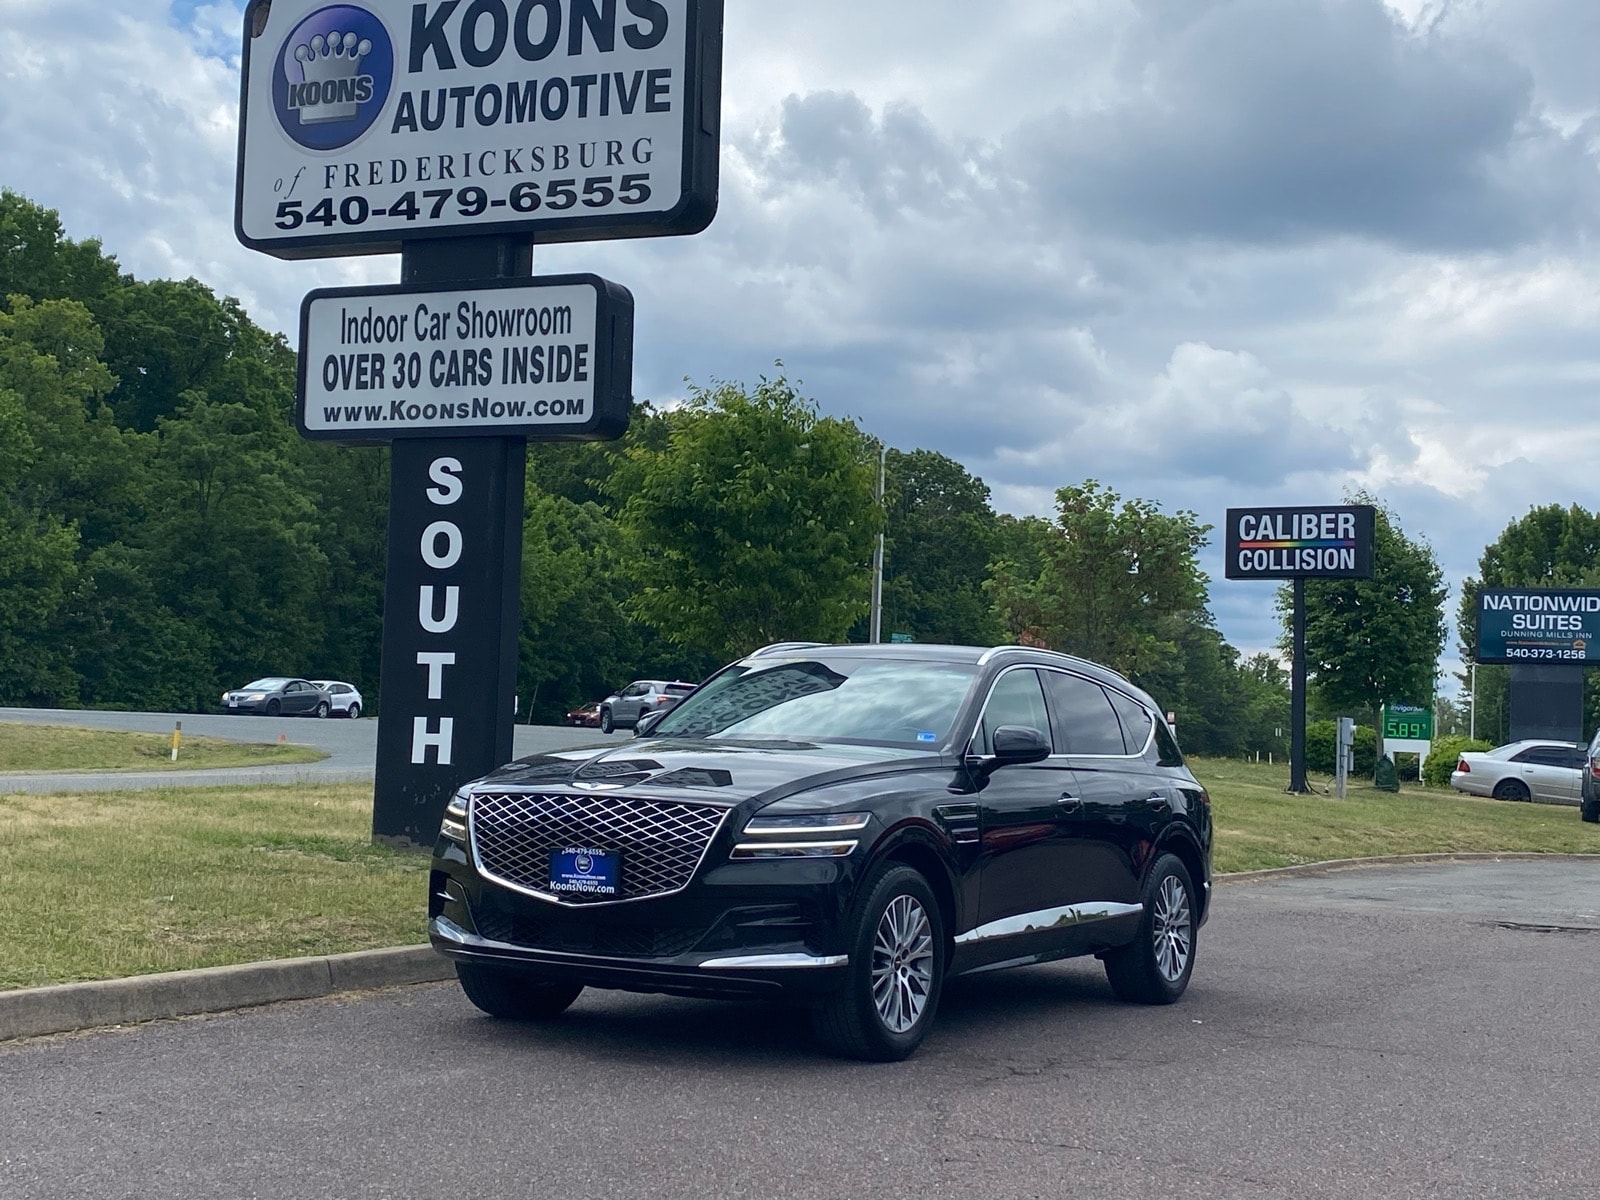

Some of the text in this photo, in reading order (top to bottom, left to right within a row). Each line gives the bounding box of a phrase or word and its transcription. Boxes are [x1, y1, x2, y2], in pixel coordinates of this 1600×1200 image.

[408, 0, 669, 73] KOONS
[288, 76, 373, 109] KOONS
[391, 68, 672, 134] AUTOMOTIVE
[274, 137, 654, 199] of FREDERICKSBURG
[274, 173, 653, 230] 540-479-6555
[341, 301, 572, 345] Indoor Car Showroom
[323, 343, 589, 392] OVER 30 CARS INSIDE
[1238, 512, 1356, 541] CALIBER
[1238, 548, 1355, 571] COLLISION
[411, 456, 463, 765] SOUTH
[1512, 614, 1583, 630] SUITES
[1500, 630, 1543, 638] DUNNING
[1546, 631, 1573, 639] MILLS
[1506, 648, 1586, 659] 540-373-1256
[550, 881, 615, 894] KoonsNow.com
